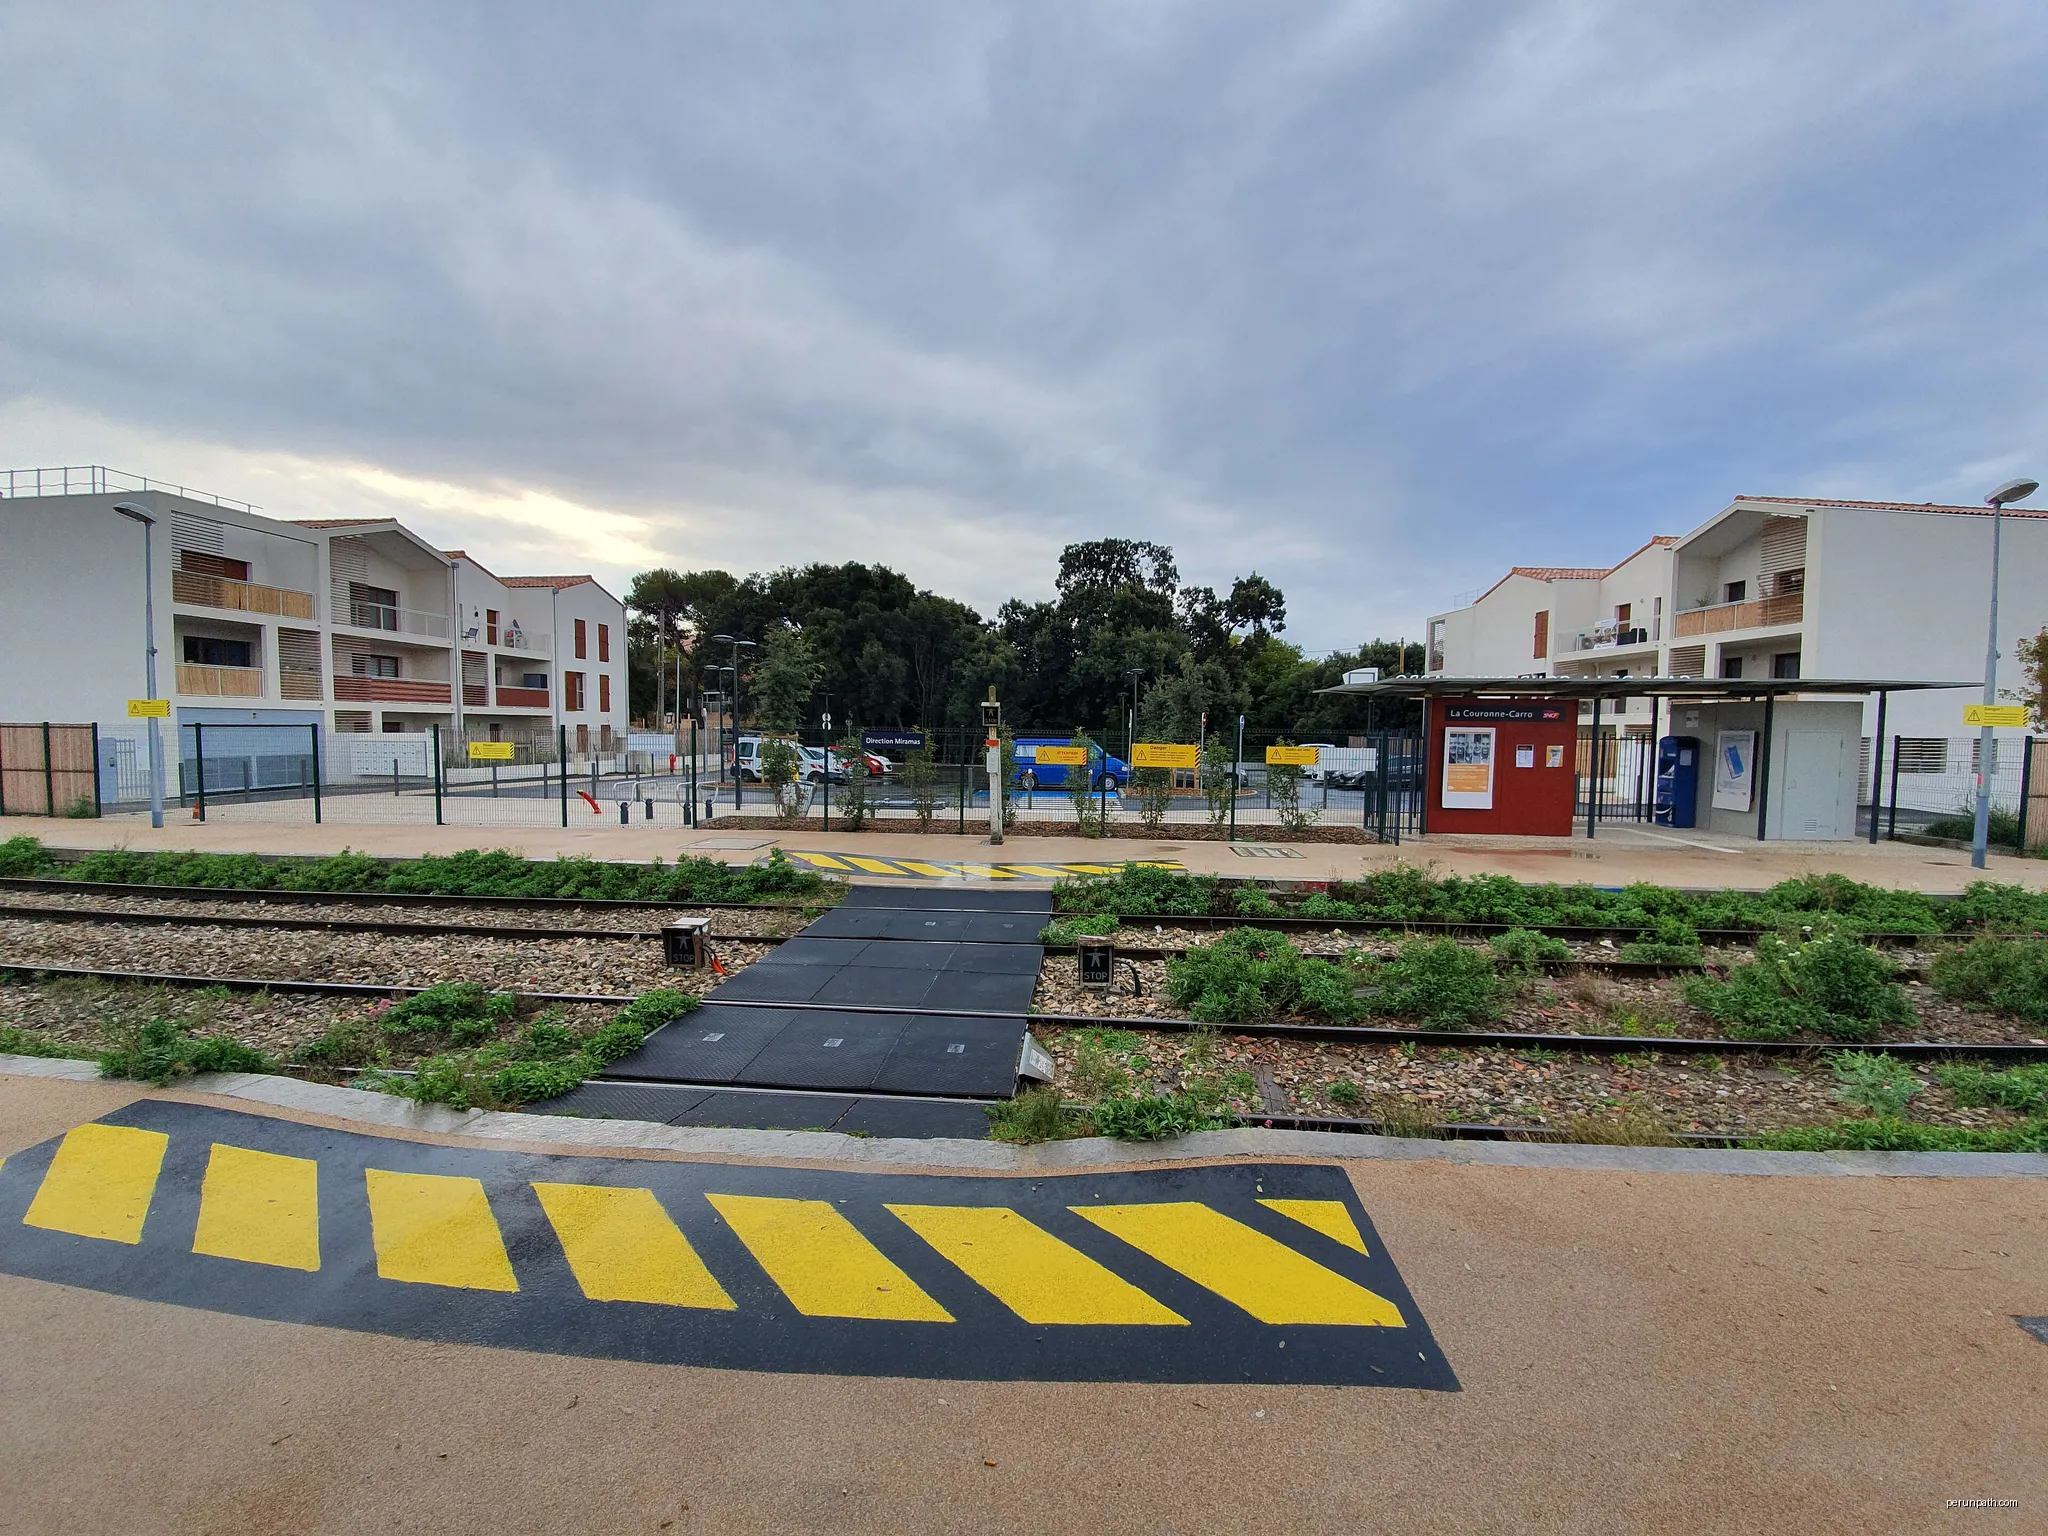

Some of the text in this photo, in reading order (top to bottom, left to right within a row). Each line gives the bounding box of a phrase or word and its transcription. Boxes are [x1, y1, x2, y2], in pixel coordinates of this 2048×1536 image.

[1450, 709, 1533, 718] La Couronne-Carro
[865, 737, 893, 745] Direction
[673, 953, 695, 963] STOP
[1084, 971, 1108, 981] STOP
